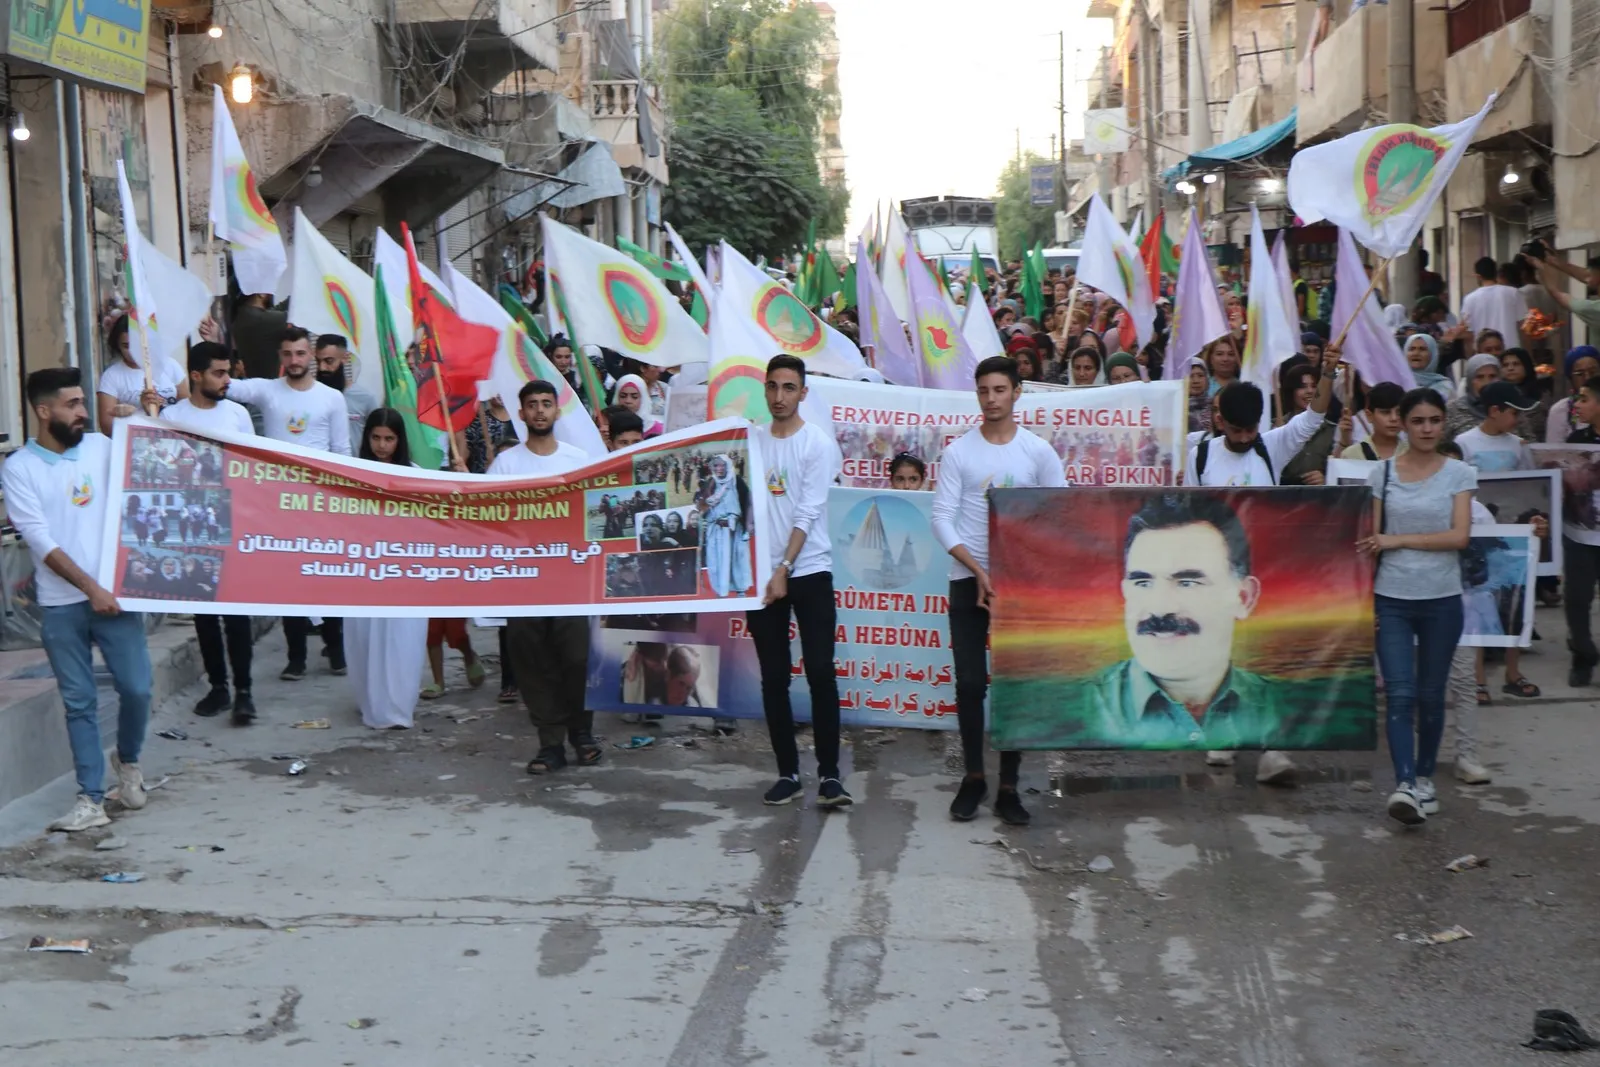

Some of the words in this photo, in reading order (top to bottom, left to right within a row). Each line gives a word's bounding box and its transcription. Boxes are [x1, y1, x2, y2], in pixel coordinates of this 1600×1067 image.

[831, 405, 986, 426] ERXWEDANIYA
[1012, 406, 1046, 426] ELÊ
[1052, 406, 1152, 431] ŞENGALÊ
[228, 459, 250, 478] DI
[594, 473, 620, 487] DE
[1104, 466, 1165, 486] BIKIN
[279, 492, 308, 511] EM
[312, 491, 325, 512] Ê
[328, 495, 380, 516] BIBIN
[513, 500, 570, 521] JINAN
[238, 534, 345, 555] افغانستان
[348, 541, 362, 559] و
[365, 540, 435, 559] شنكال
[438, 543, 487, 559] نساء
[490, 541, 569, 561] شخصية
[571, 541, 602, 564] في
[301, 560, 366, 577] النساء
[369, 562, 403, 581] كل
[405, 564, 460, 581] صوت
[463, 564, 538, 582] سنكون
[923, 595, 952, 614] JIN
[855, 622, 941, 648] HEBÛNA
[860, 656, 900, 684] المرأة
[904, 662, 952, 687] كرامة
[865, 690, 919, 715] كرامة
